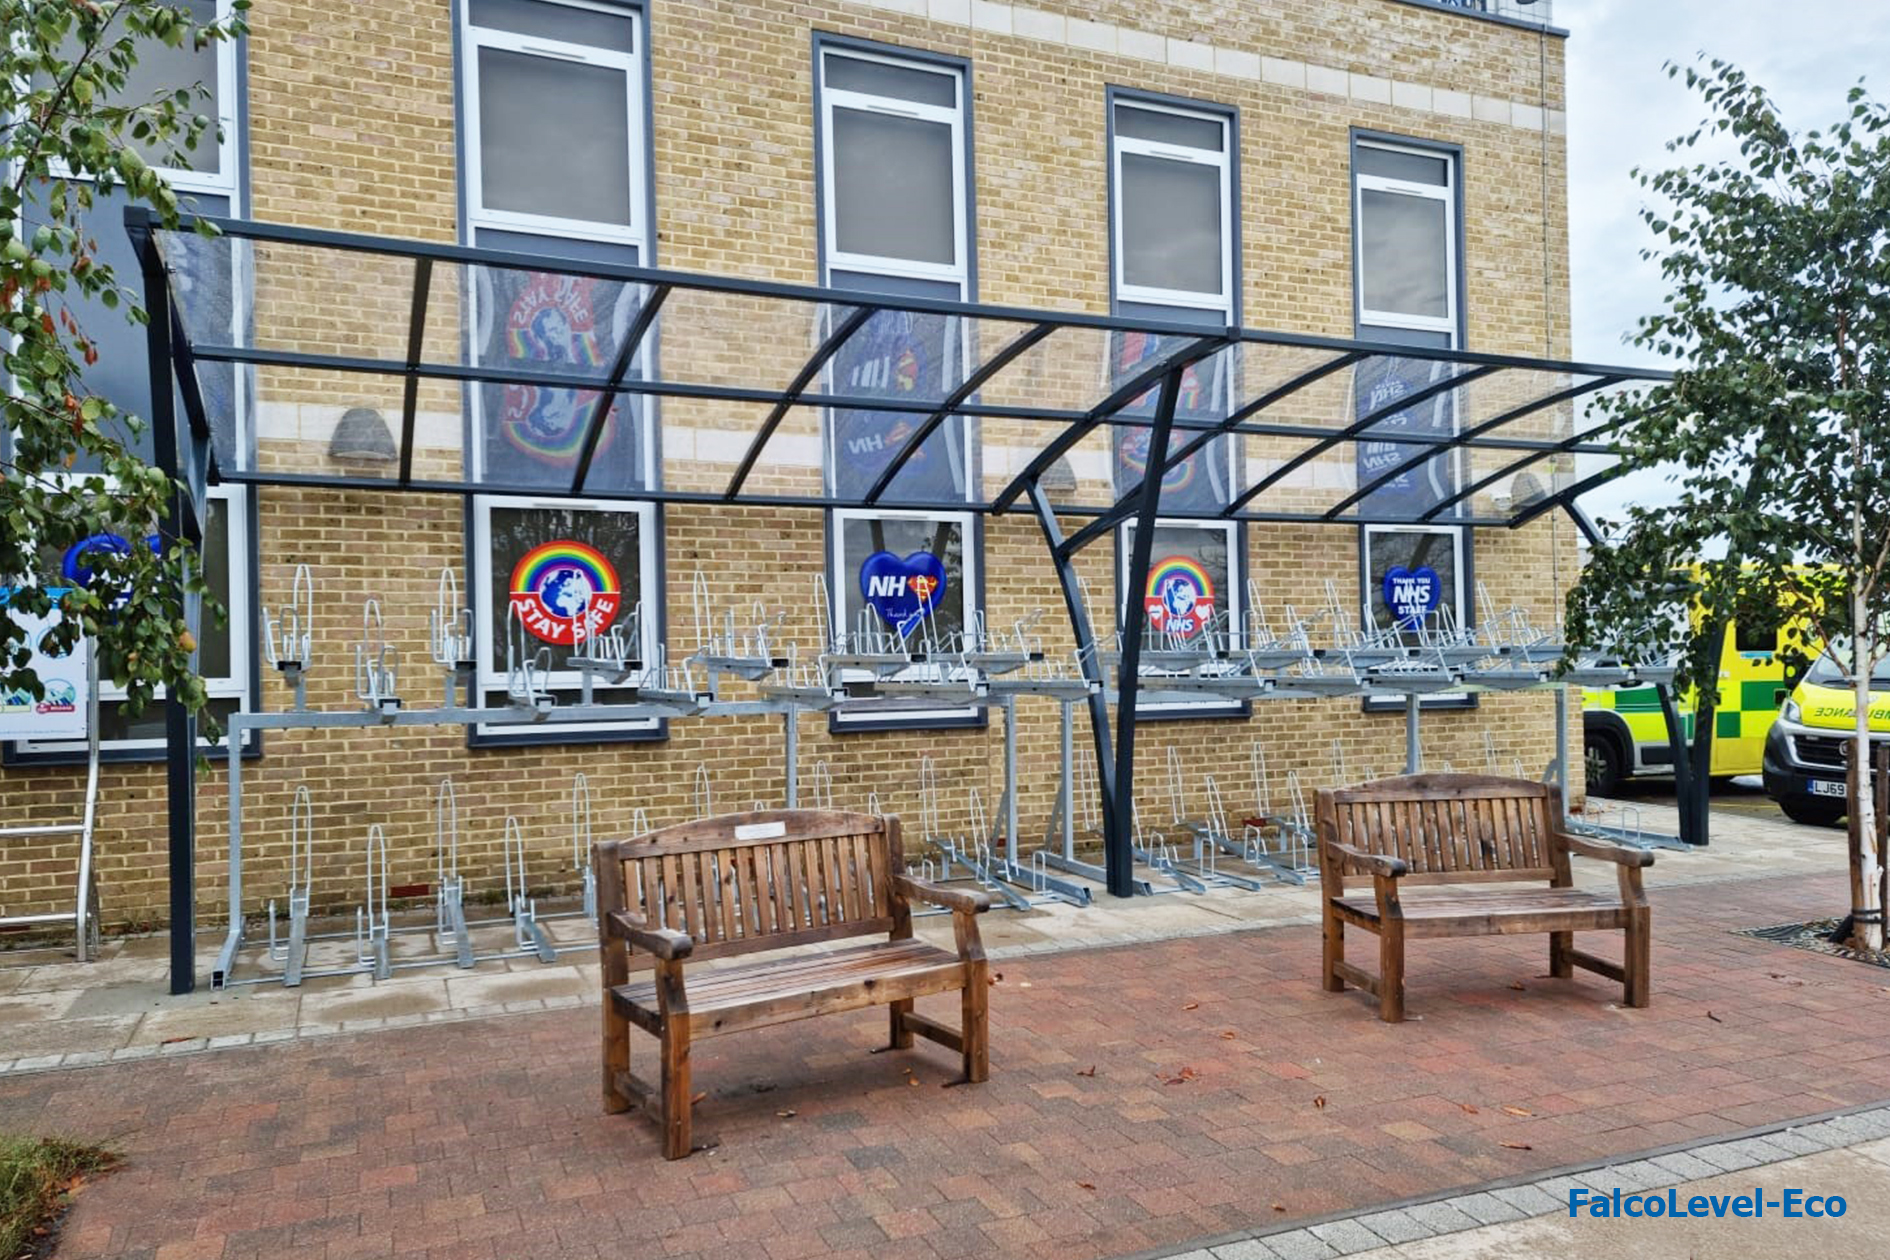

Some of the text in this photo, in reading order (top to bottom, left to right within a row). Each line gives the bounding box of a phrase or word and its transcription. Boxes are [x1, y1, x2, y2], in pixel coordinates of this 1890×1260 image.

[1393, 585, 1431, 603] NHS
[519, 598, 566, 639] STAY
[1166, 618, 1194, 632] NHS
[1815, 781, 1845, 796] LJ69
